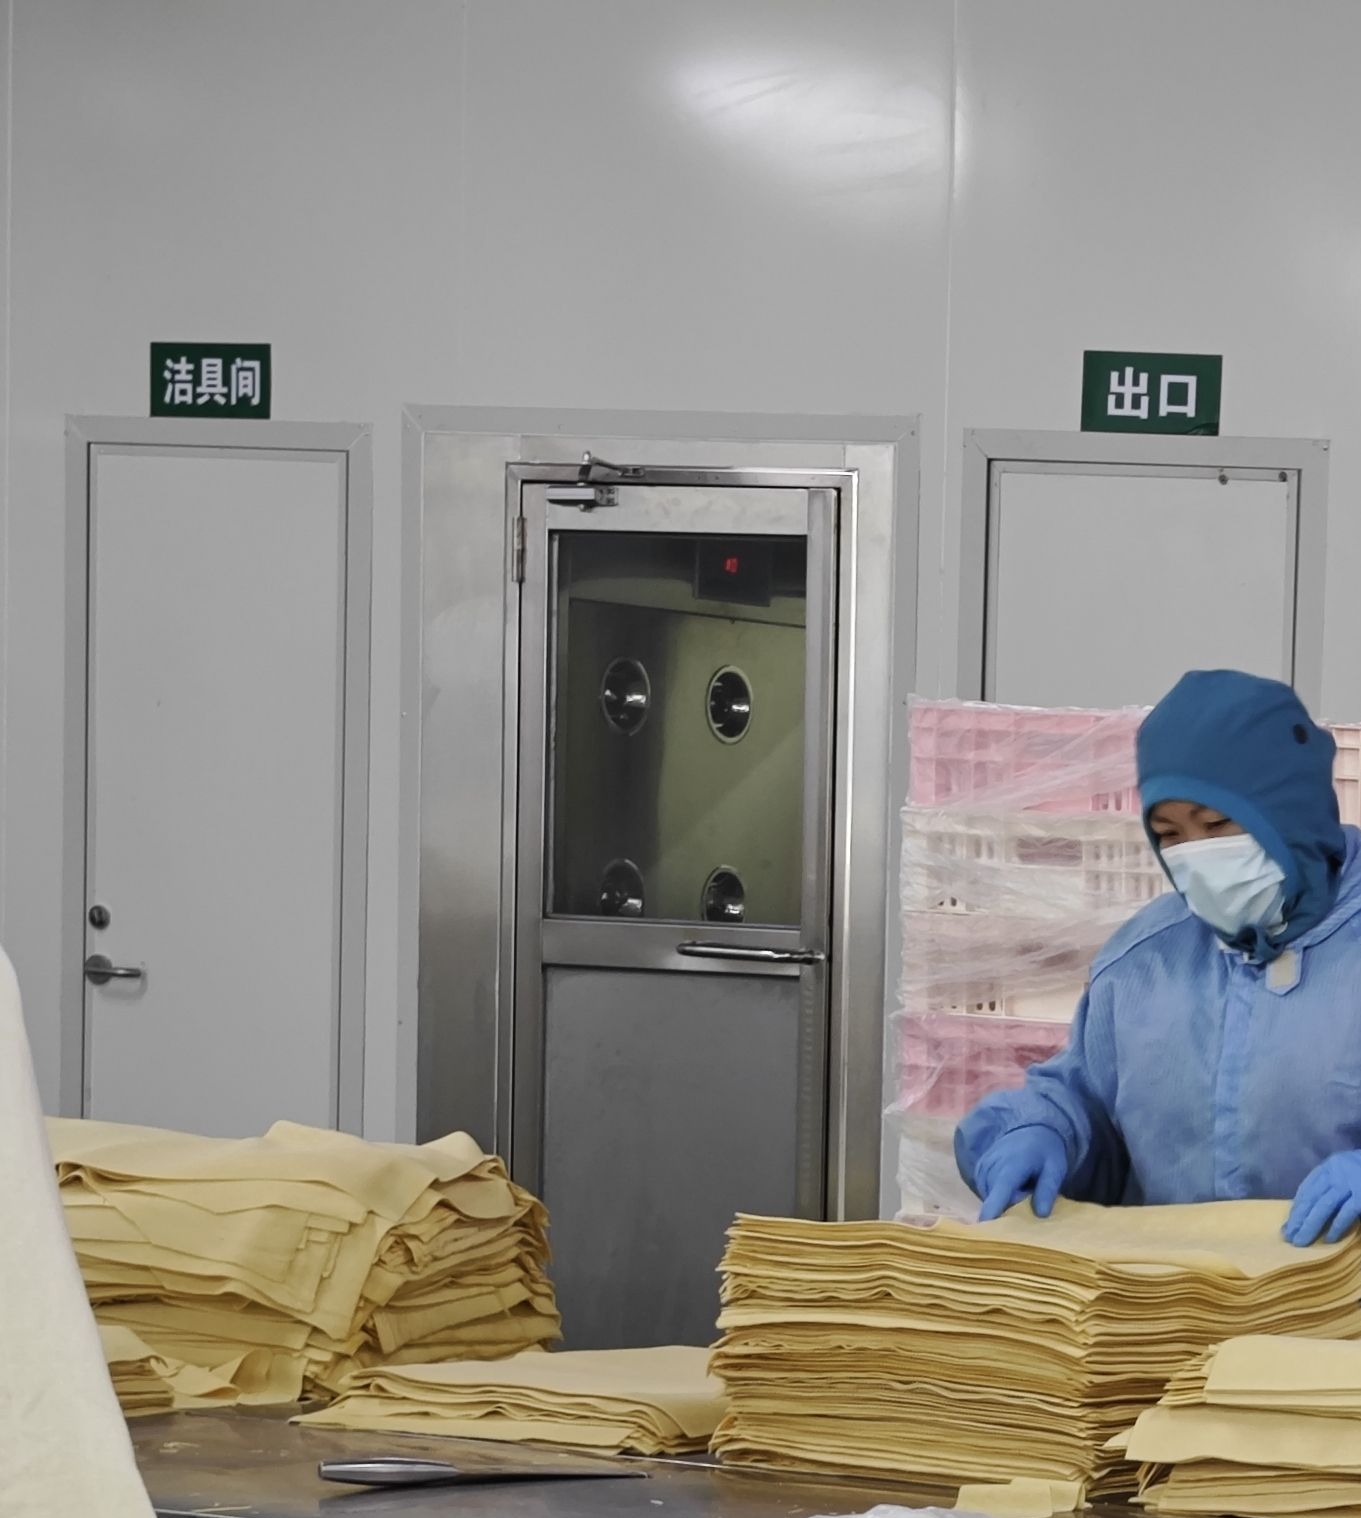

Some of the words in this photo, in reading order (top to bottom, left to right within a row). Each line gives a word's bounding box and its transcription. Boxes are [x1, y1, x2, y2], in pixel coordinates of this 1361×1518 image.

[163, 356, 261, 406] 洁具间
[1107, 366, 1197, 420] 出口
